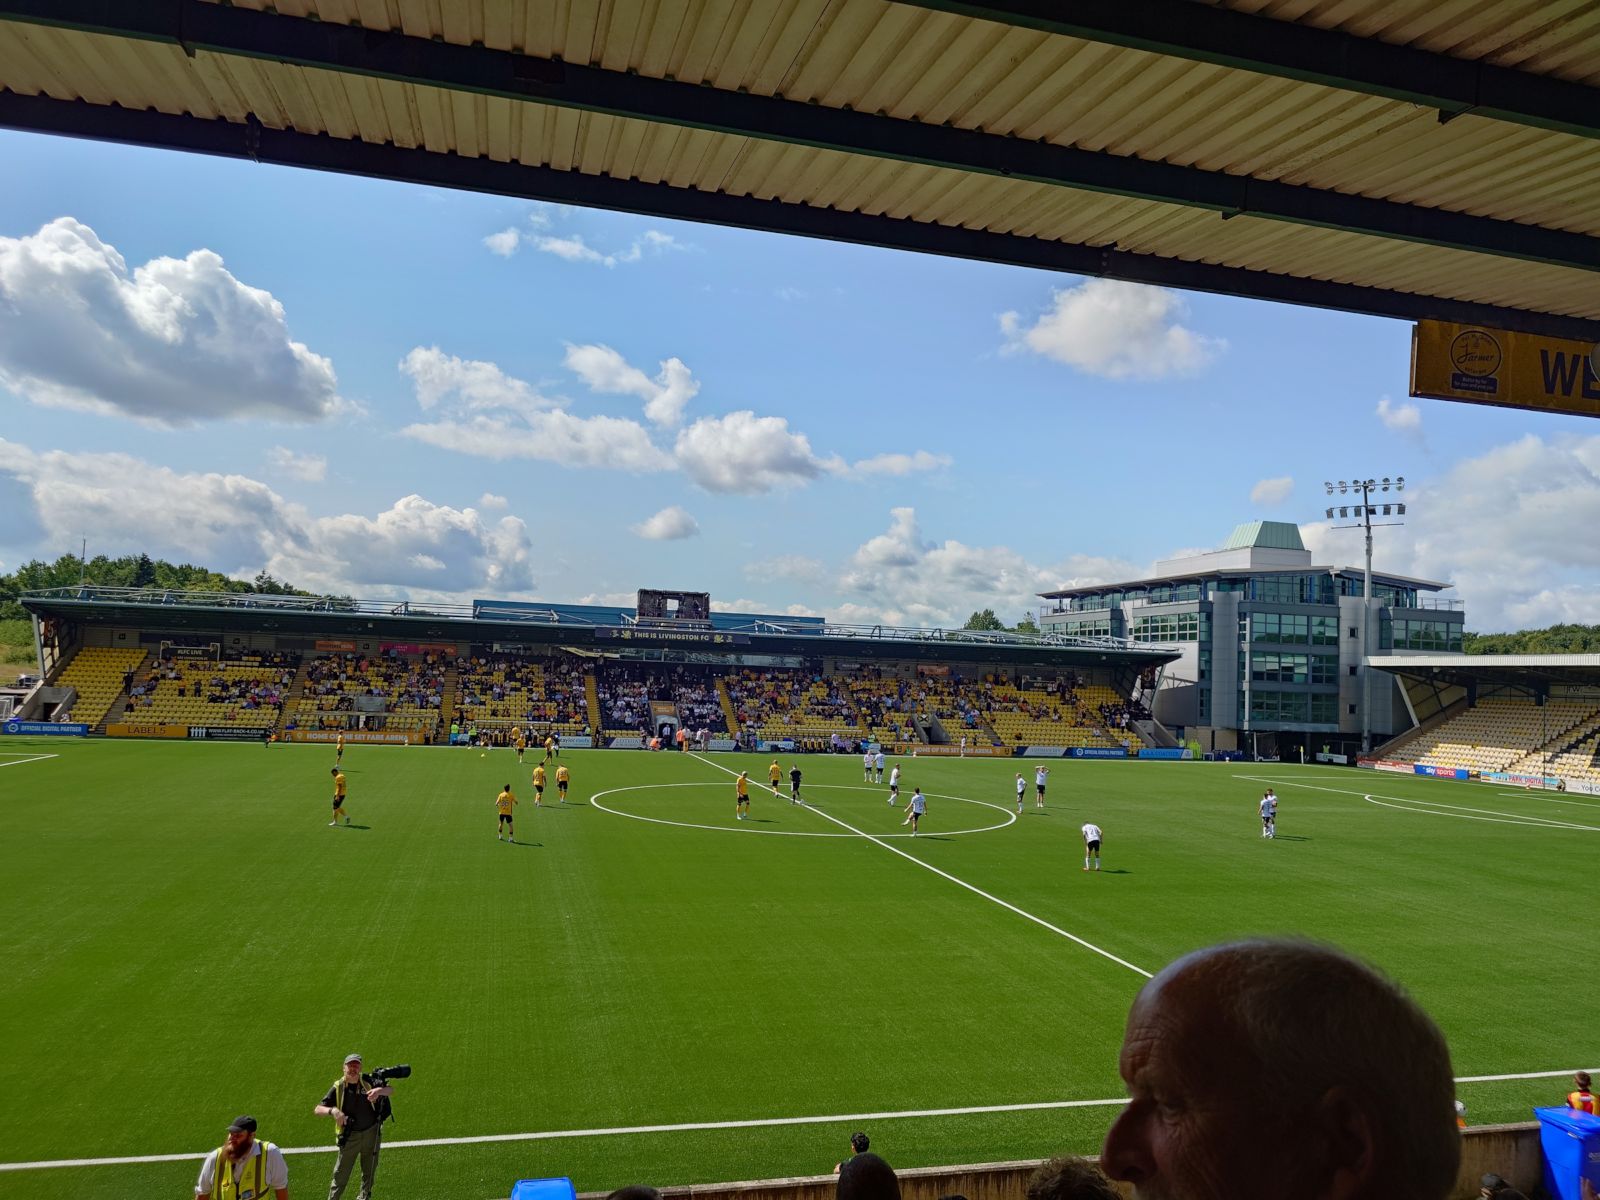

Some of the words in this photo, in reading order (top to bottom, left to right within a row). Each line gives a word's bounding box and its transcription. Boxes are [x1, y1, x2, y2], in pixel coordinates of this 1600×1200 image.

[658, 633, 699, 641] LIVINGSTON
[1426, 766, 1436, 775] sky
[1436, 768, 1455, 777] sports
